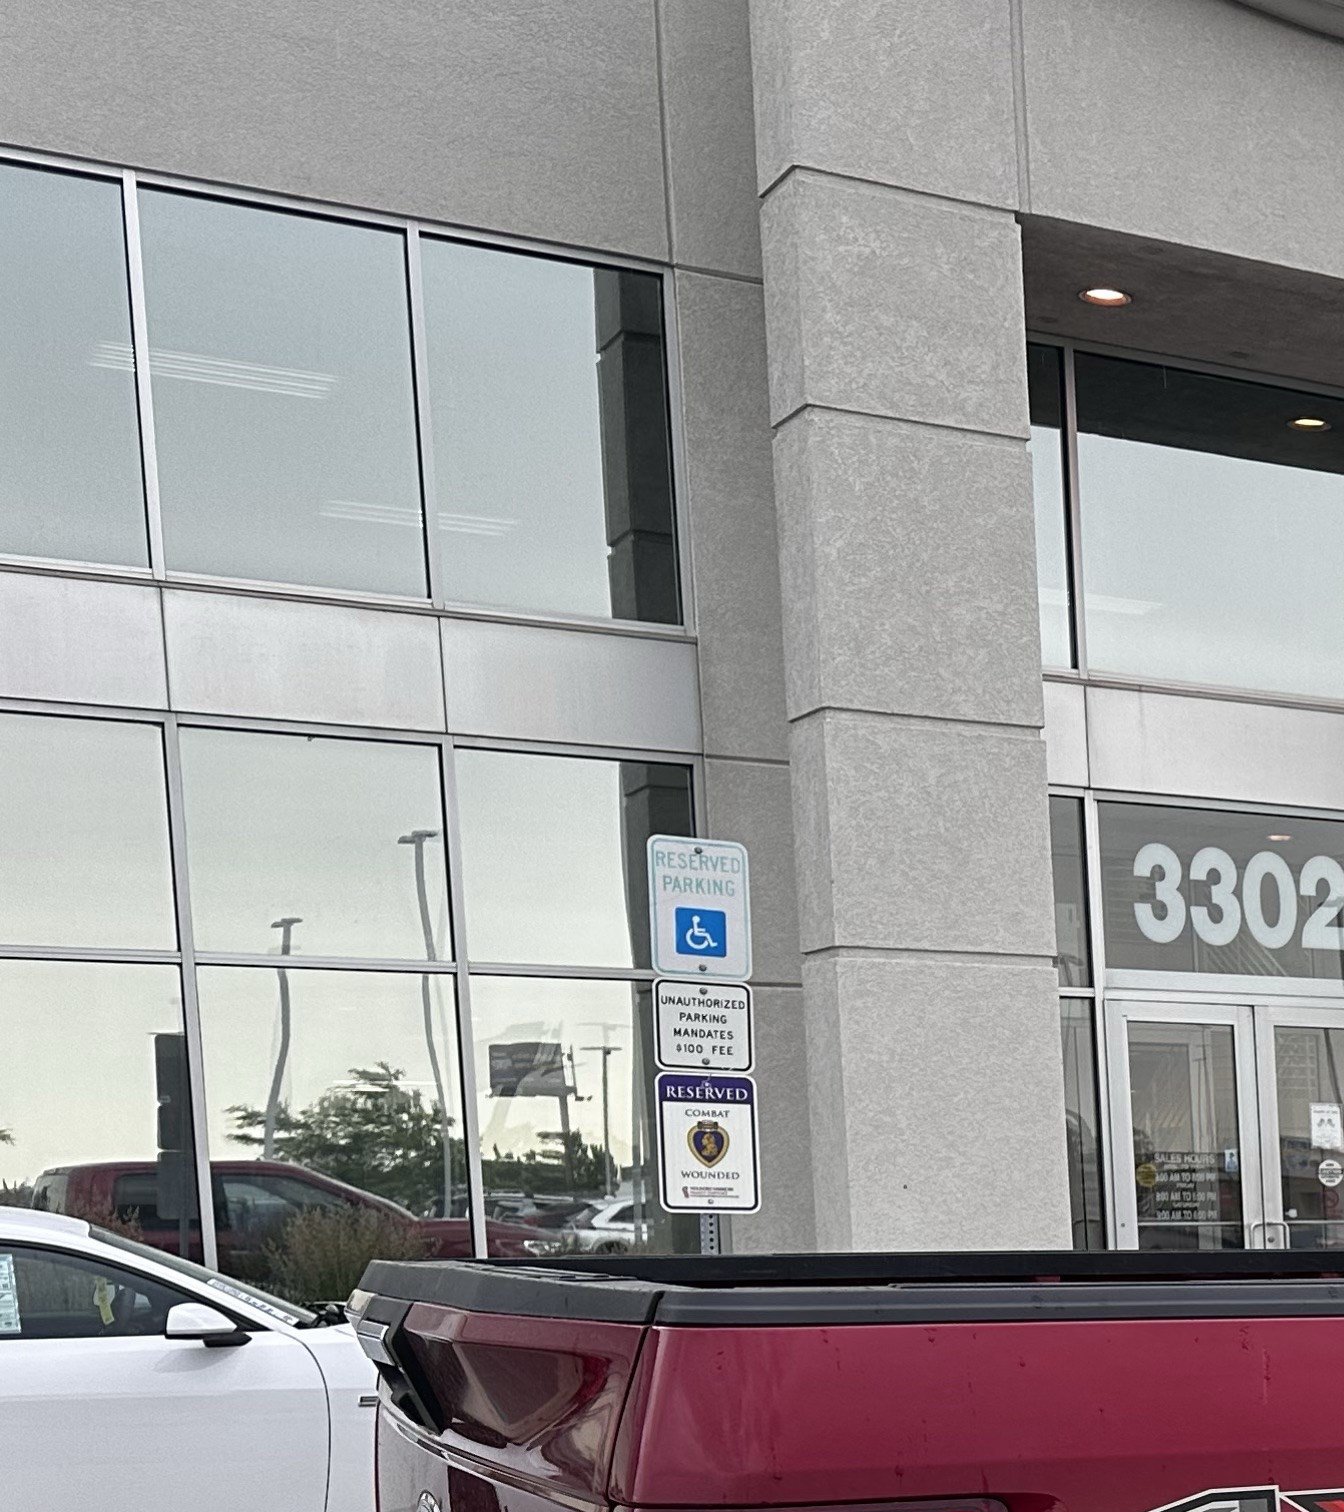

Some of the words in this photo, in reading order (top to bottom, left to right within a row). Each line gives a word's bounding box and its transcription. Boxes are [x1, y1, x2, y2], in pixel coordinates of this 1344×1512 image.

[655, 851, 740, 874] RESERVED
[662, 875, 735, 897] PARKING
[660, 995, 746, 1010] UNAUTHORIZED
[679, 1012, 728, 1024] PARKING
[673, 1027, 734, 1040] MANDATES
[676, 1043, 703, 1054] $100
[711, 1045, 734, 1056] FEE
[666, 1085, 749, 1101] RESERVED
[684, 1108, 731, 1118] COMBAT
[681, 1170, 740, 1180] WOUNDED
